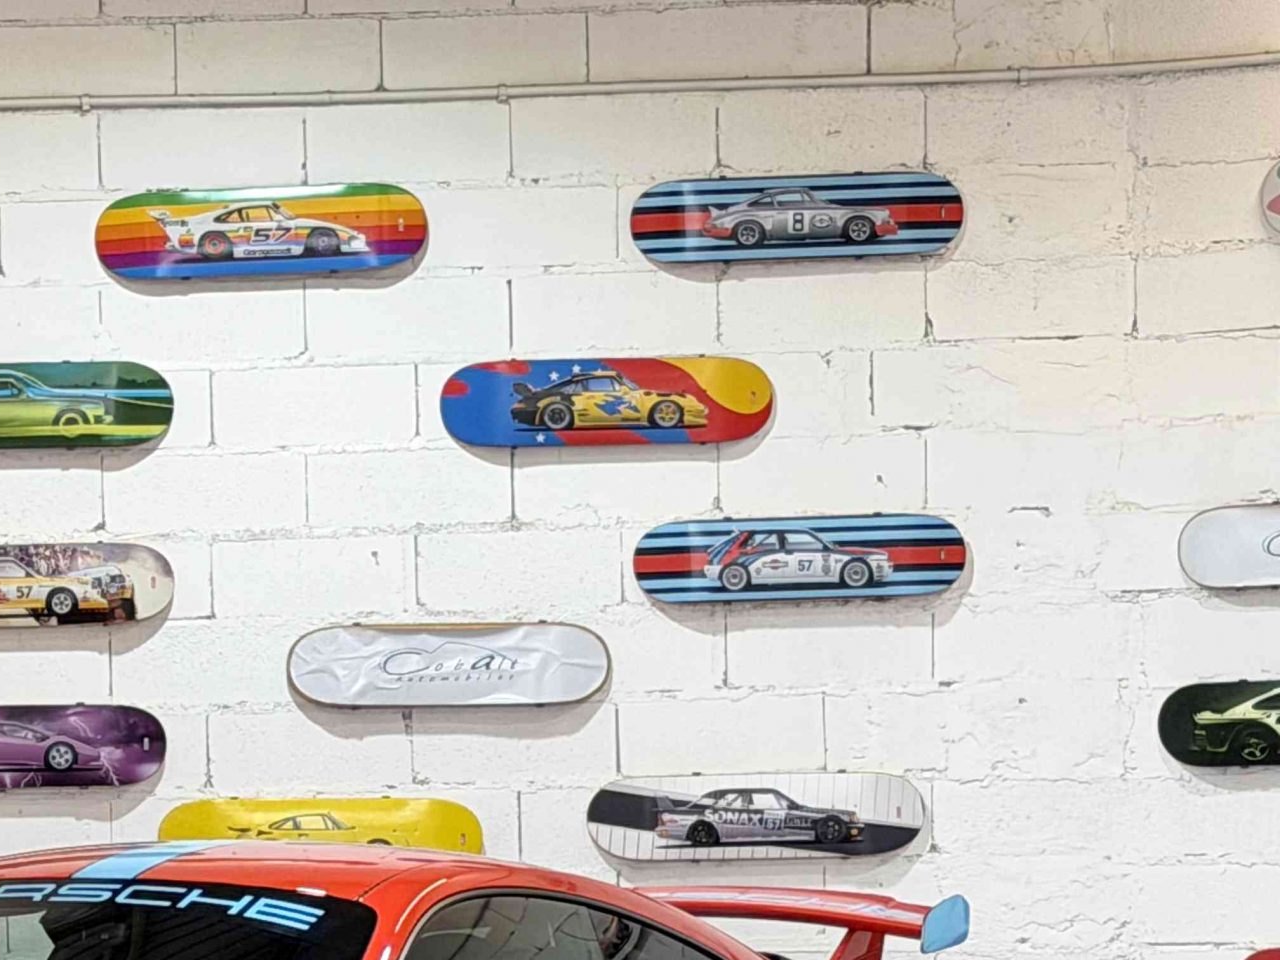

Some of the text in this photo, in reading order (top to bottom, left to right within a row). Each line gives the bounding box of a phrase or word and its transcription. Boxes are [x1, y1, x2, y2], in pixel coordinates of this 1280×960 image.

[793, 212, 804, 231] 8
[252, 227, 293, 243] 57
[798, 559, 813, 572] 57
[16, 586, 33, 599] 57
[381, 649, 519, 676] Cobalt
[703, 808, 762, 826] SONAX
